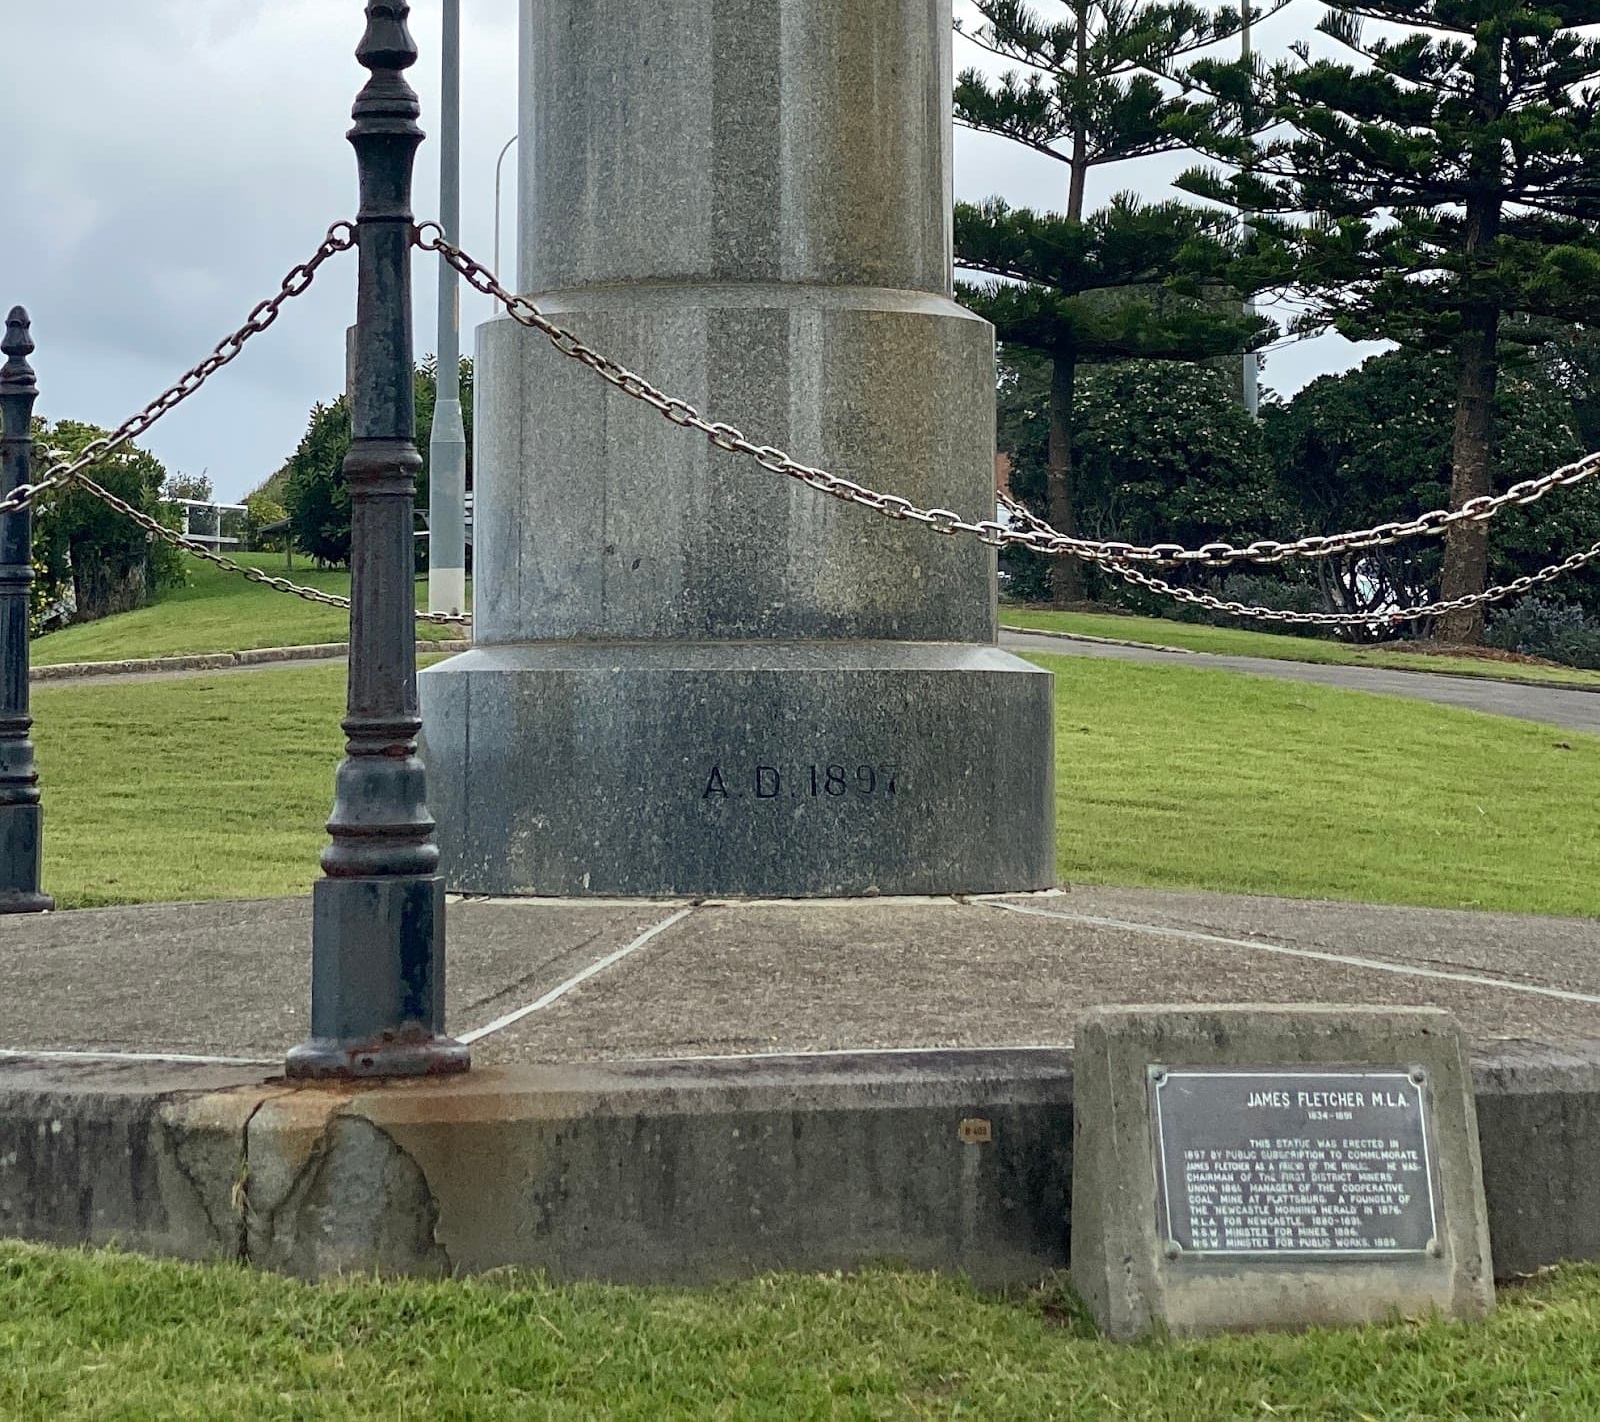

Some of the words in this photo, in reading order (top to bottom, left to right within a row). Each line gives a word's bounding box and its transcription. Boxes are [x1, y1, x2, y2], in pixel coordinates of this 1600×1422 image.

[1247, 1091, 1291, 1108] JAMES
[1298, 1091, 1365, 1108] FLETCHER
[1372, 1091, 1410, 1108] M.L.A.
[1249, 1139, 1271, 1149] THIS
[1276, 1139, 1311, 1149] STATUE
[1317, 1139, 1337, 1149] WAS
[1343, 1139, 1385, 1149] ERECTED
[1390, 1139, 1400, 1149] IN
[1210, 1150, 1222, 1160] BY
[1225, 1150, 1257, 1160] PUBLIC
[1260, 1150, 1325, 1160] SUBSCRIPTION
[1330, 1150, 1342, 1160] TO
[1347, 1150, 1419, 1160] COMMEMORATE
[1186, 1161, 1210, 1171] JAMES
[1214, 1161, 1250, 1171] FLETCHER
[1254, 1161, 1265, 1171] AS
[1268, 1161, 1275, 1171] A
[1279, 1161, 1305, 1171] FRIEND
[1308, 1161, 1318, 1171] OF
[1323, 1161, 1337, 1171] THE
[1186, 1172, 1234, 1183] CHAIRMAN
[1240, 1172, 1252, 1183] OF
[1259, 1172, 1277, 1183] THE
[1281, 1172, 1306, 1183] FIRST
[1311, 1172, 1352, 1183] DISTRICT
[1249, 1183, 1294, 1194] MANAGER
[1299, 1183, 1312, 1194] OF
[1317, 1183, 1336, 1194] THE
[1342, 1183, 1405, 1194] COOPERATIVE
[1188, 1194, 1213, 1205] COAL
[1220, 1194, 1244, 1205] MINE
[1249, 1194, 1260, 1205] AT
[1338, 1194, 1346, 1205] A
[1350, 1194, 1393, 1205] FOUNDER
[1398, 1194, 1411, 1205] OF
[1190, 1205, 1209, 1216] THE
[1274, 1205, 1317, 1216] MORNING
[1363, 1205, 1374, 1216] IN
[1223, 1216, 1242, 1227] FOR
[1225, 1227, 1269, 1238] MINISTER
[1274, 1227, 1293, 1238] FOR
[1225, 1238, 1270, 1249] MINISTER
[1275, 1238, 1294, 1249] FOR
[1300, 1238, 1331, 1249] PUBLIC
